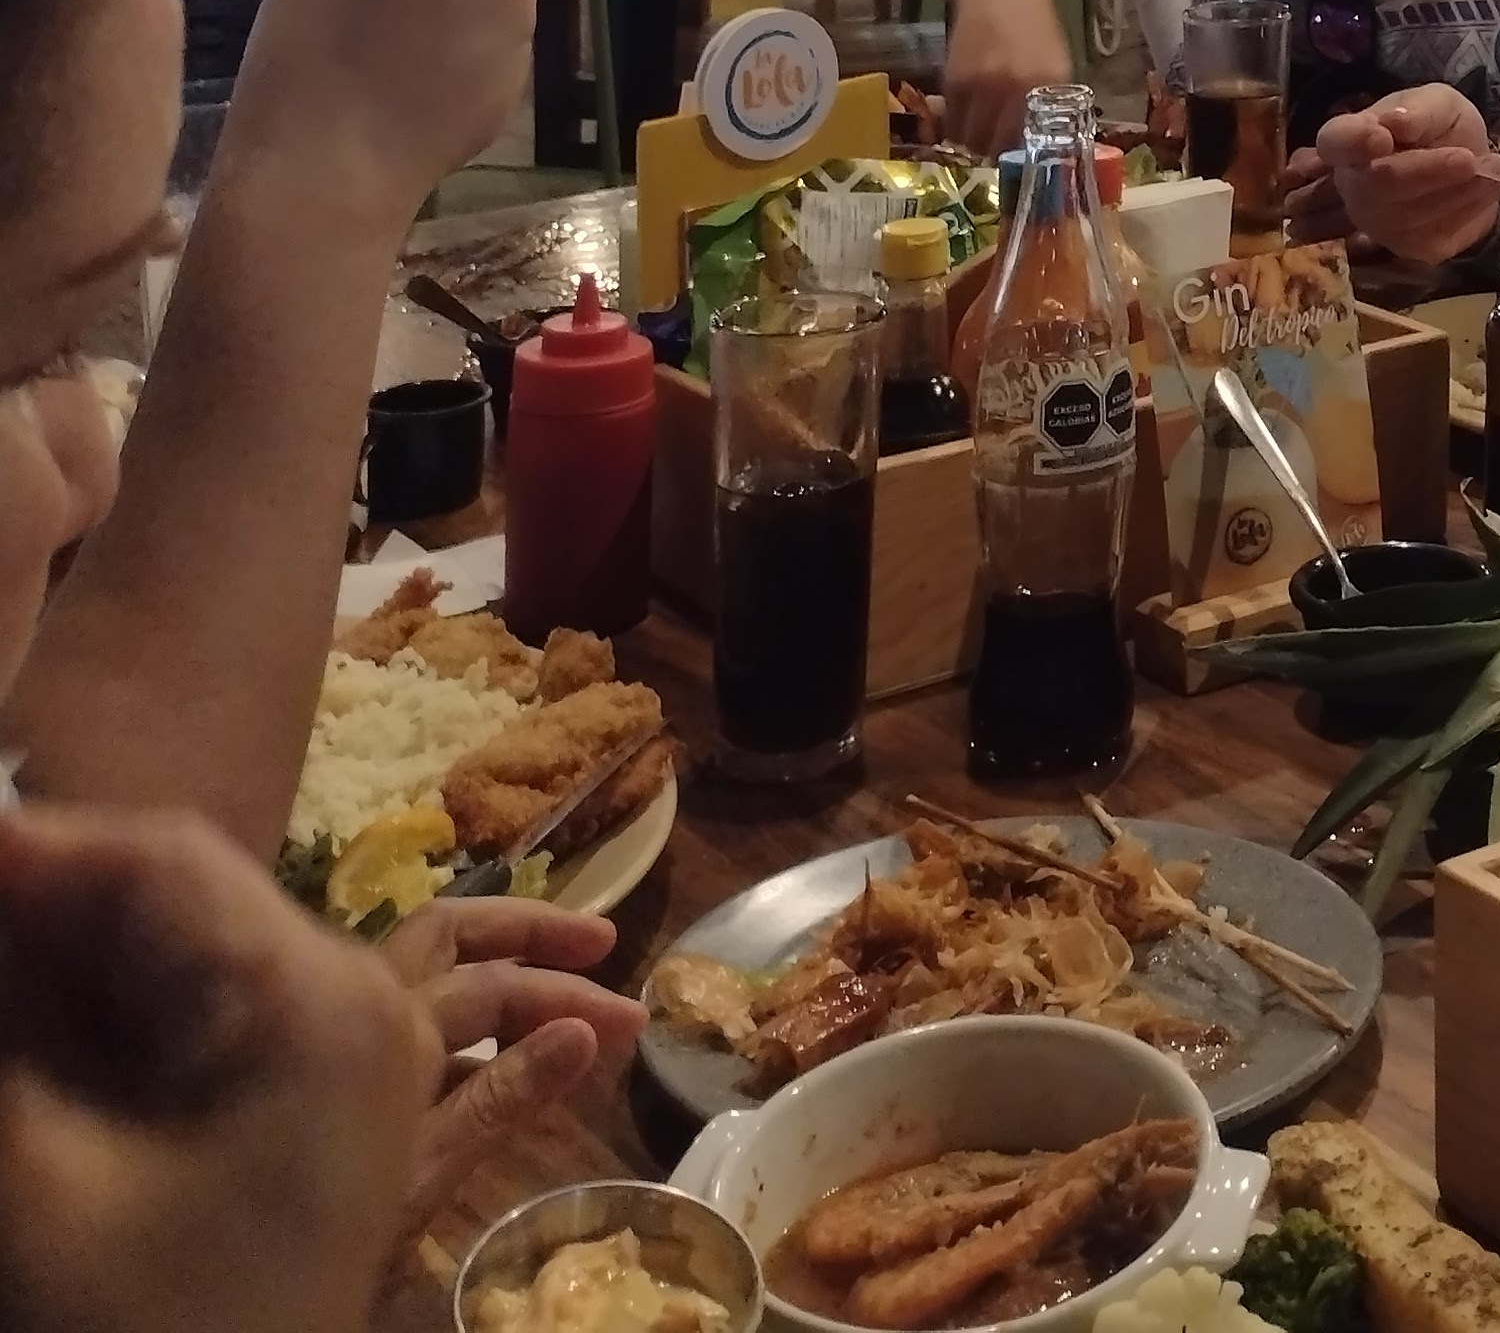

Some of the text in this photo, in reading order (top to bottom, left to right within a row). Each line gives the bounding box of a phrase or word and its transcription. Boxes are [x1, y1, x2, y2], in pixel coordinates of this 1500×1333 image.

[1173, 271, 1251, 324] Gin
[1221, 307, 1260, 353] Del
[1053, 402, 1092, 415] EXCESO
